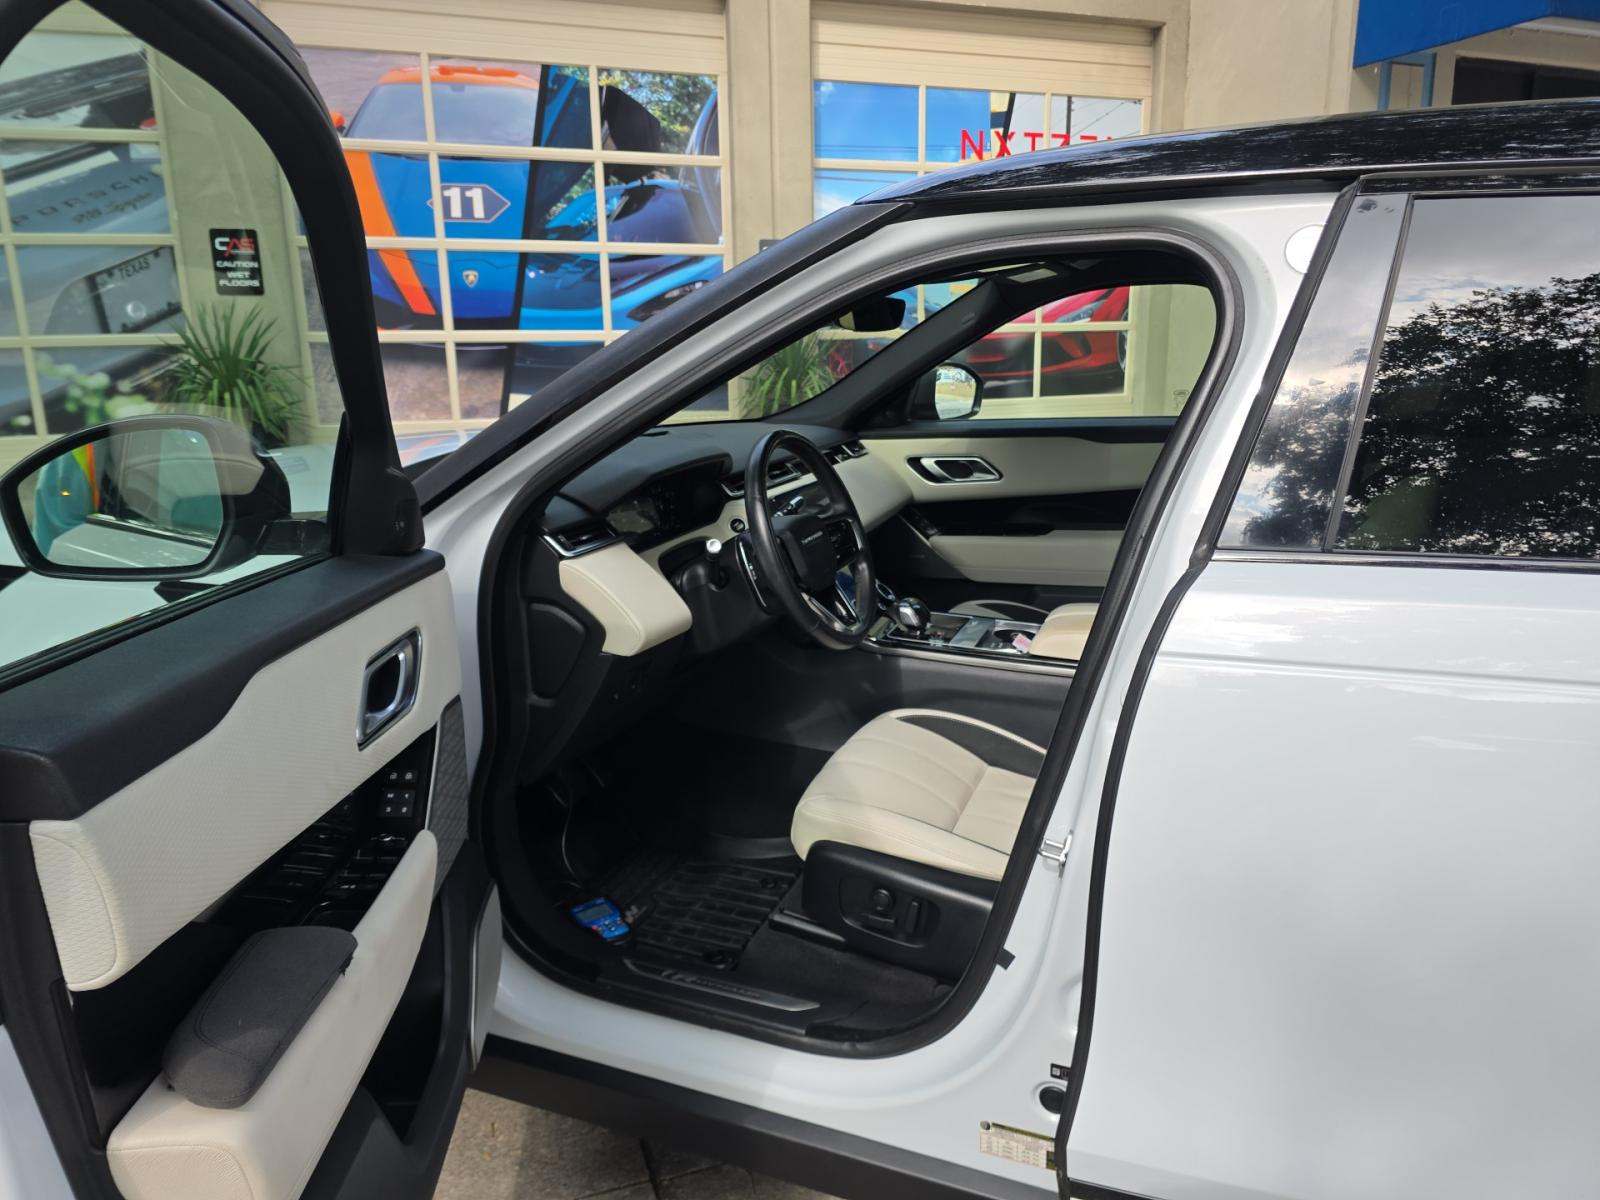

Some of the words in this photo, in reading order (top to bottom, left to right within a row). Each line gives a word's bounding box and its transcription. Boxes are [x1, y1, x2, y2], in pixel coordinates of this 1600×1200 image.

[443, 186, 485, 219] 11
[118, 257, 151, 279] TEXAS
[216, 260, 259, 268] CAUTION
